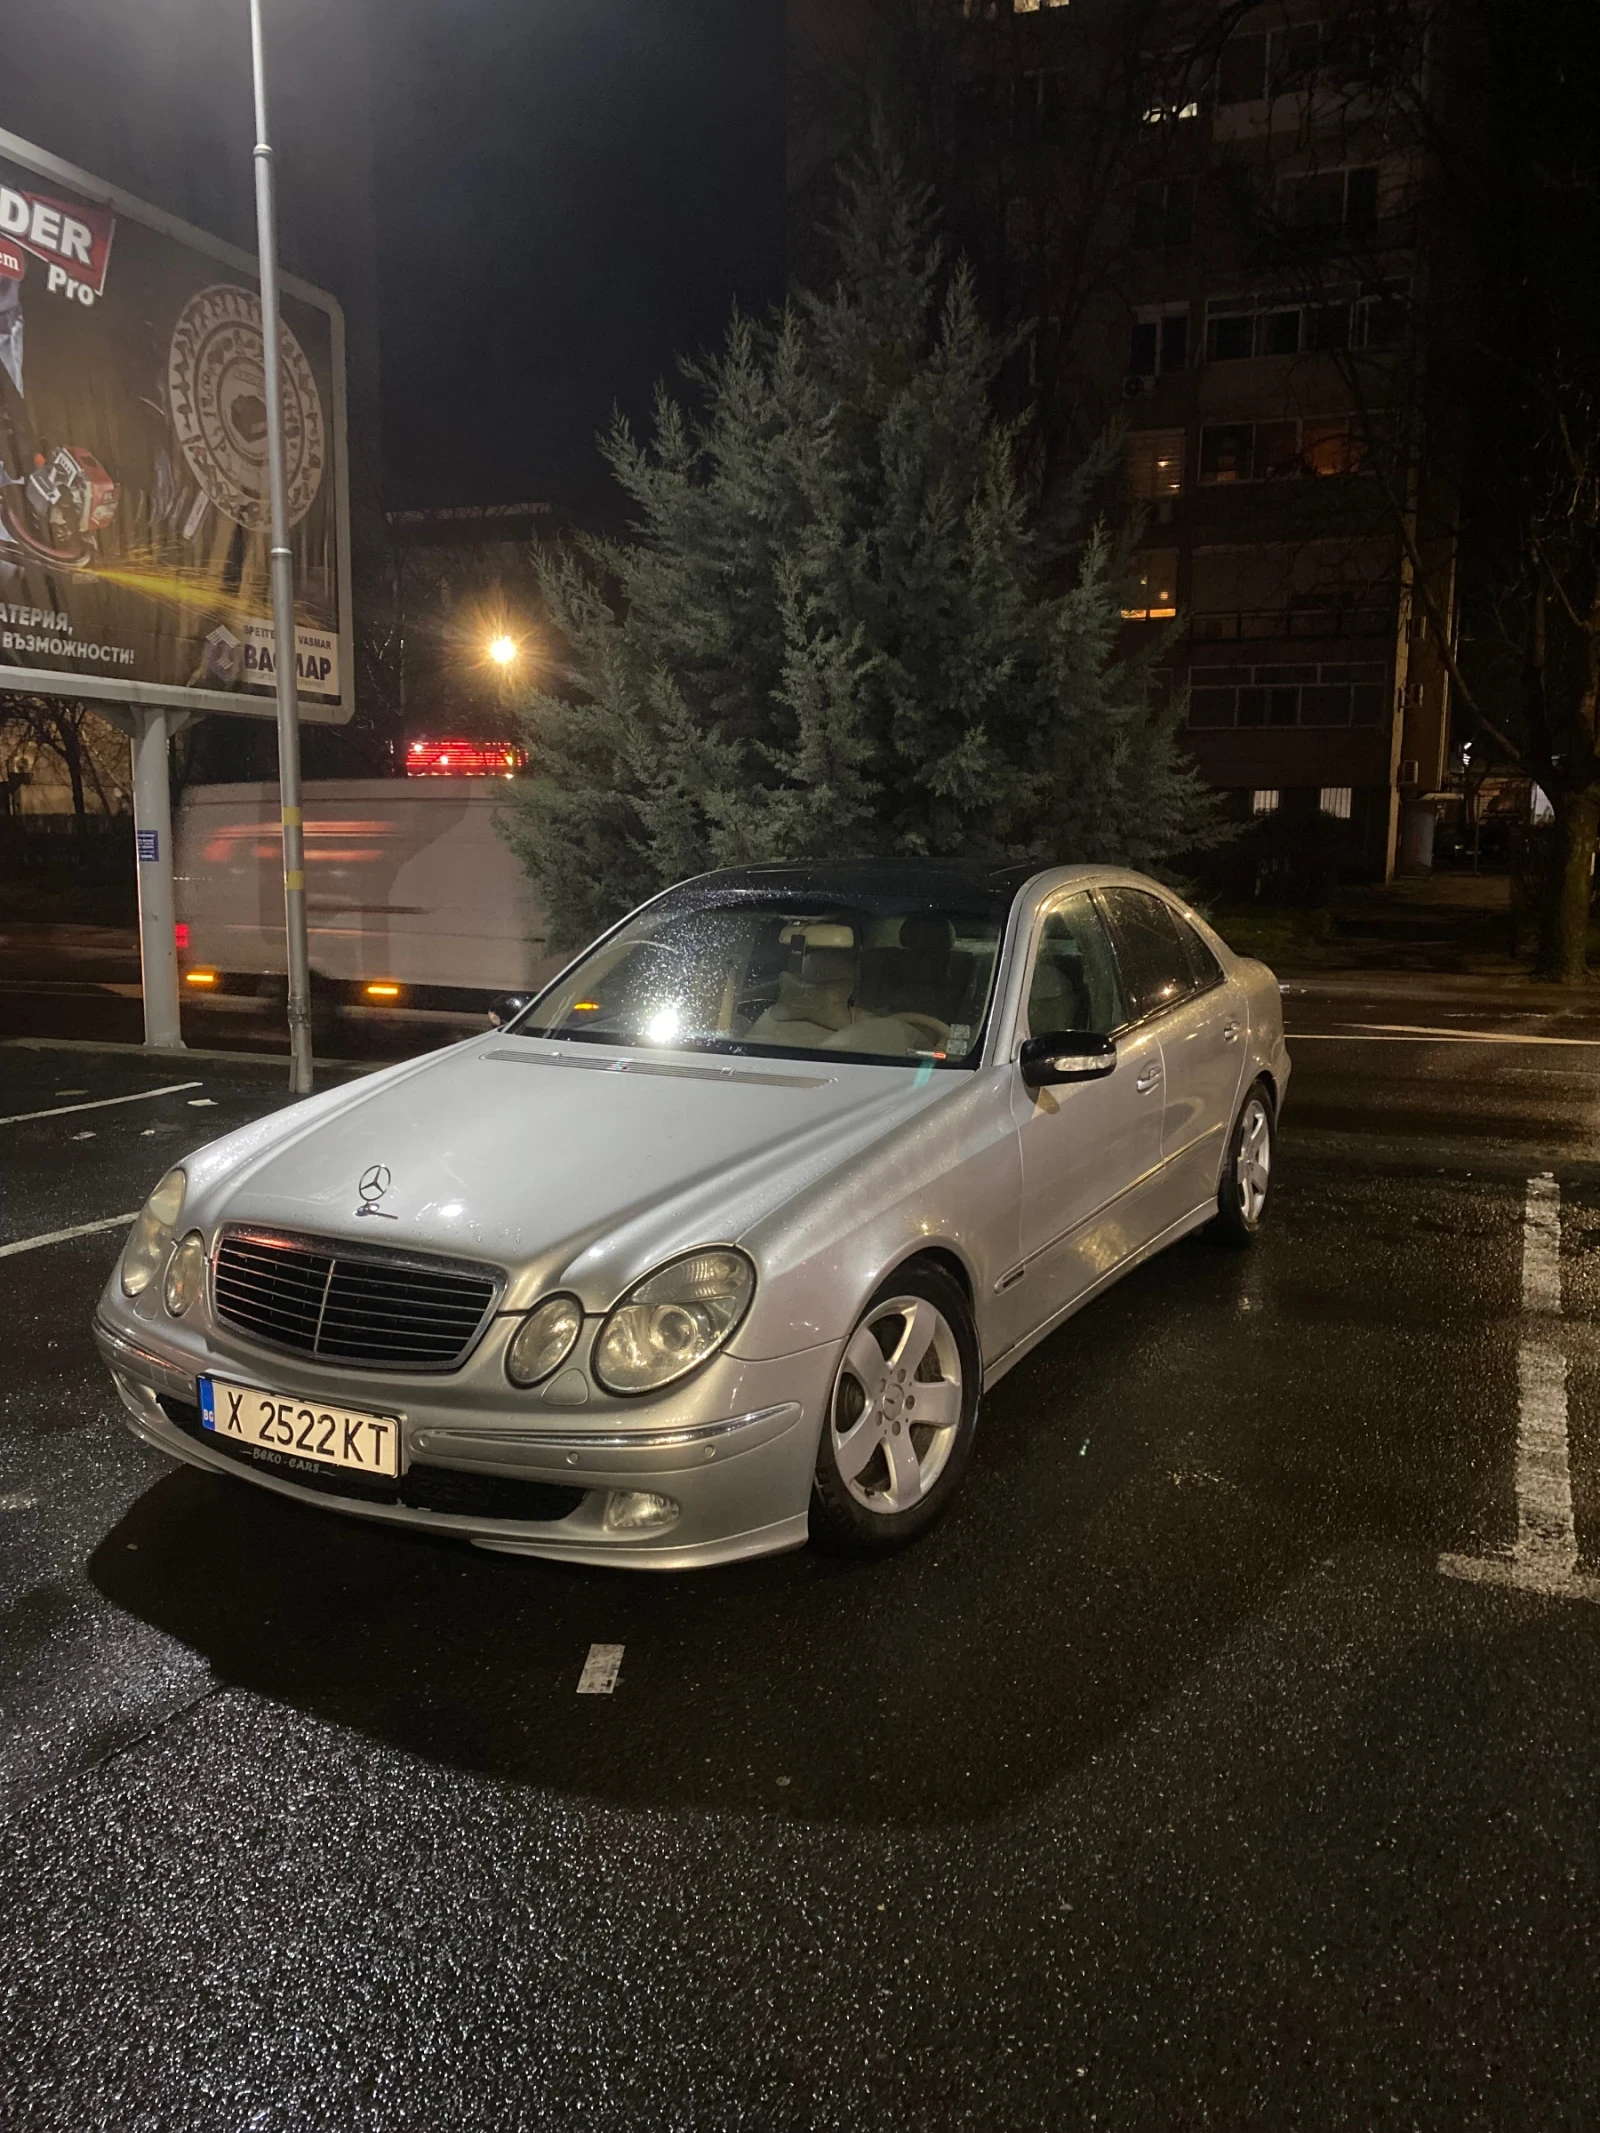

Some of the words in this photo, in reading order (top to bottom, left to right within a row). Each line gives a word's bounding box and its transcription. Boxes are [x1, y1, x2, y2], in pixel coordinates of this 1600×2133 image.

[47, 263, 95, 306] Pro
[2, 631, 135, 664] ВЪЗМОЖНОСТИ!
[244, 643, 332, 681] ВААР
[203, 1409, 214, 1422] BG
[227, 1391, 243, 1434] X
